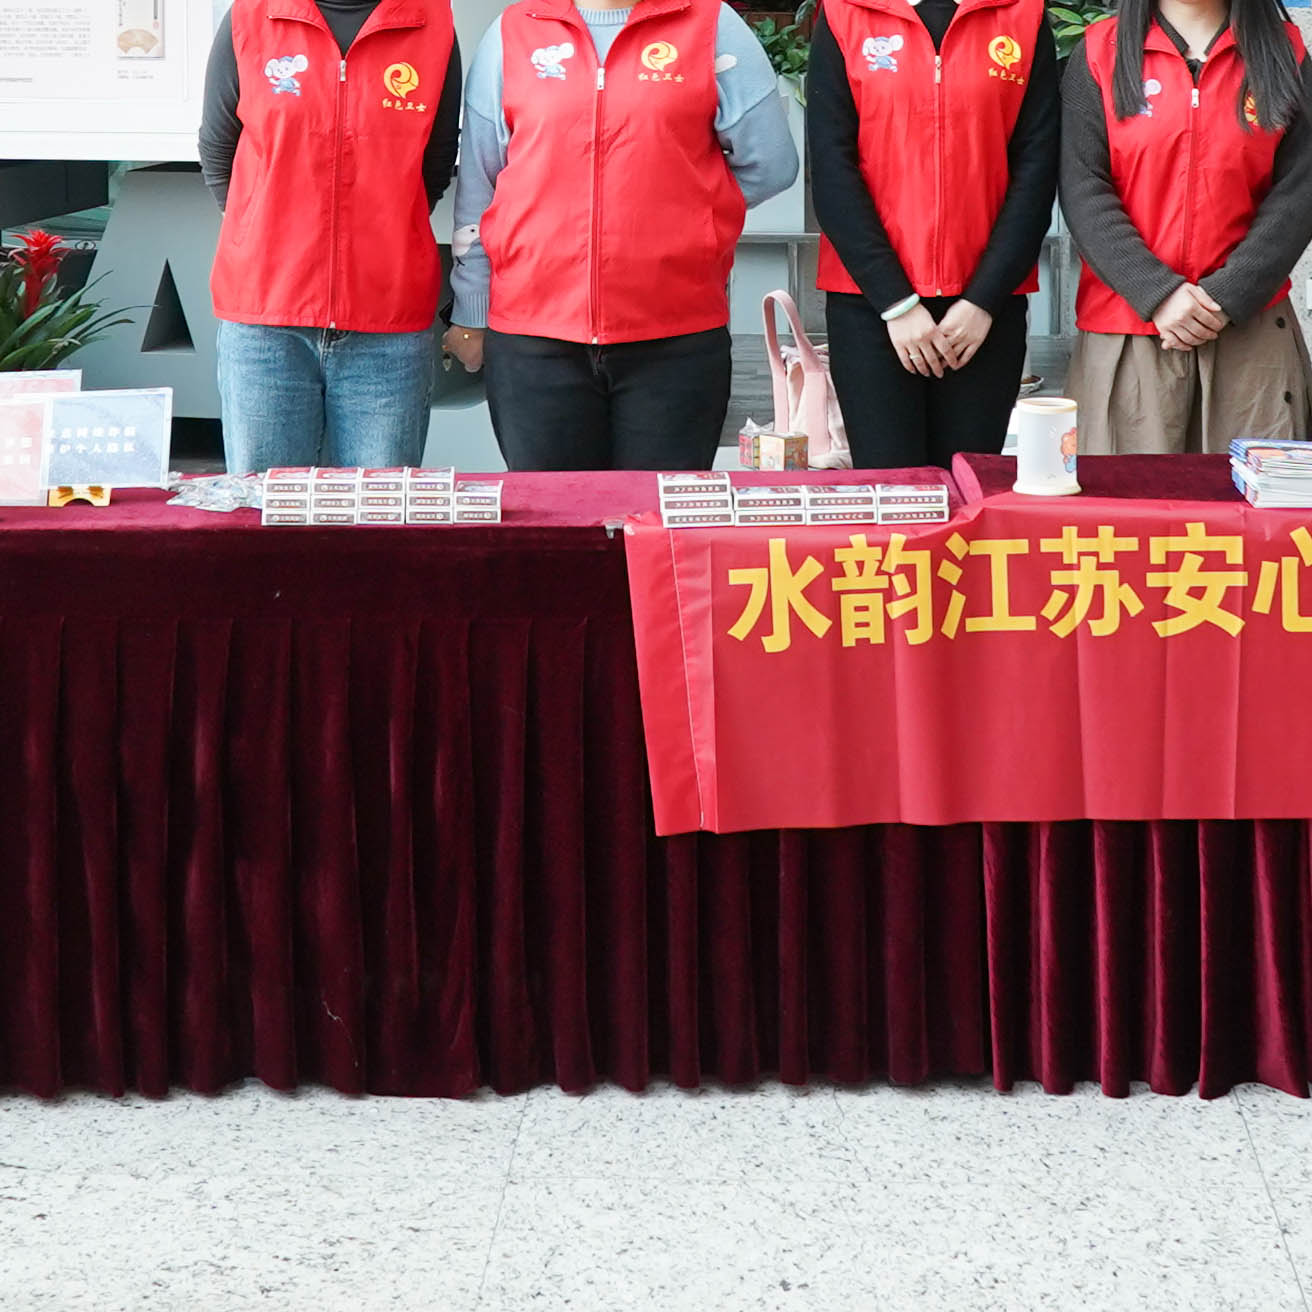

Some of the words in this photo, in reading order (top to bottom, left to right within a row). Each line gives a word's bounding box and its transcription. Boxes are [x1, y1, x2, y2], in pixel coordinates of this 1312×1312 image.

[638, 73, 685, 84] 红色卫士
[382, 99, 427, 113] 红色卫士
